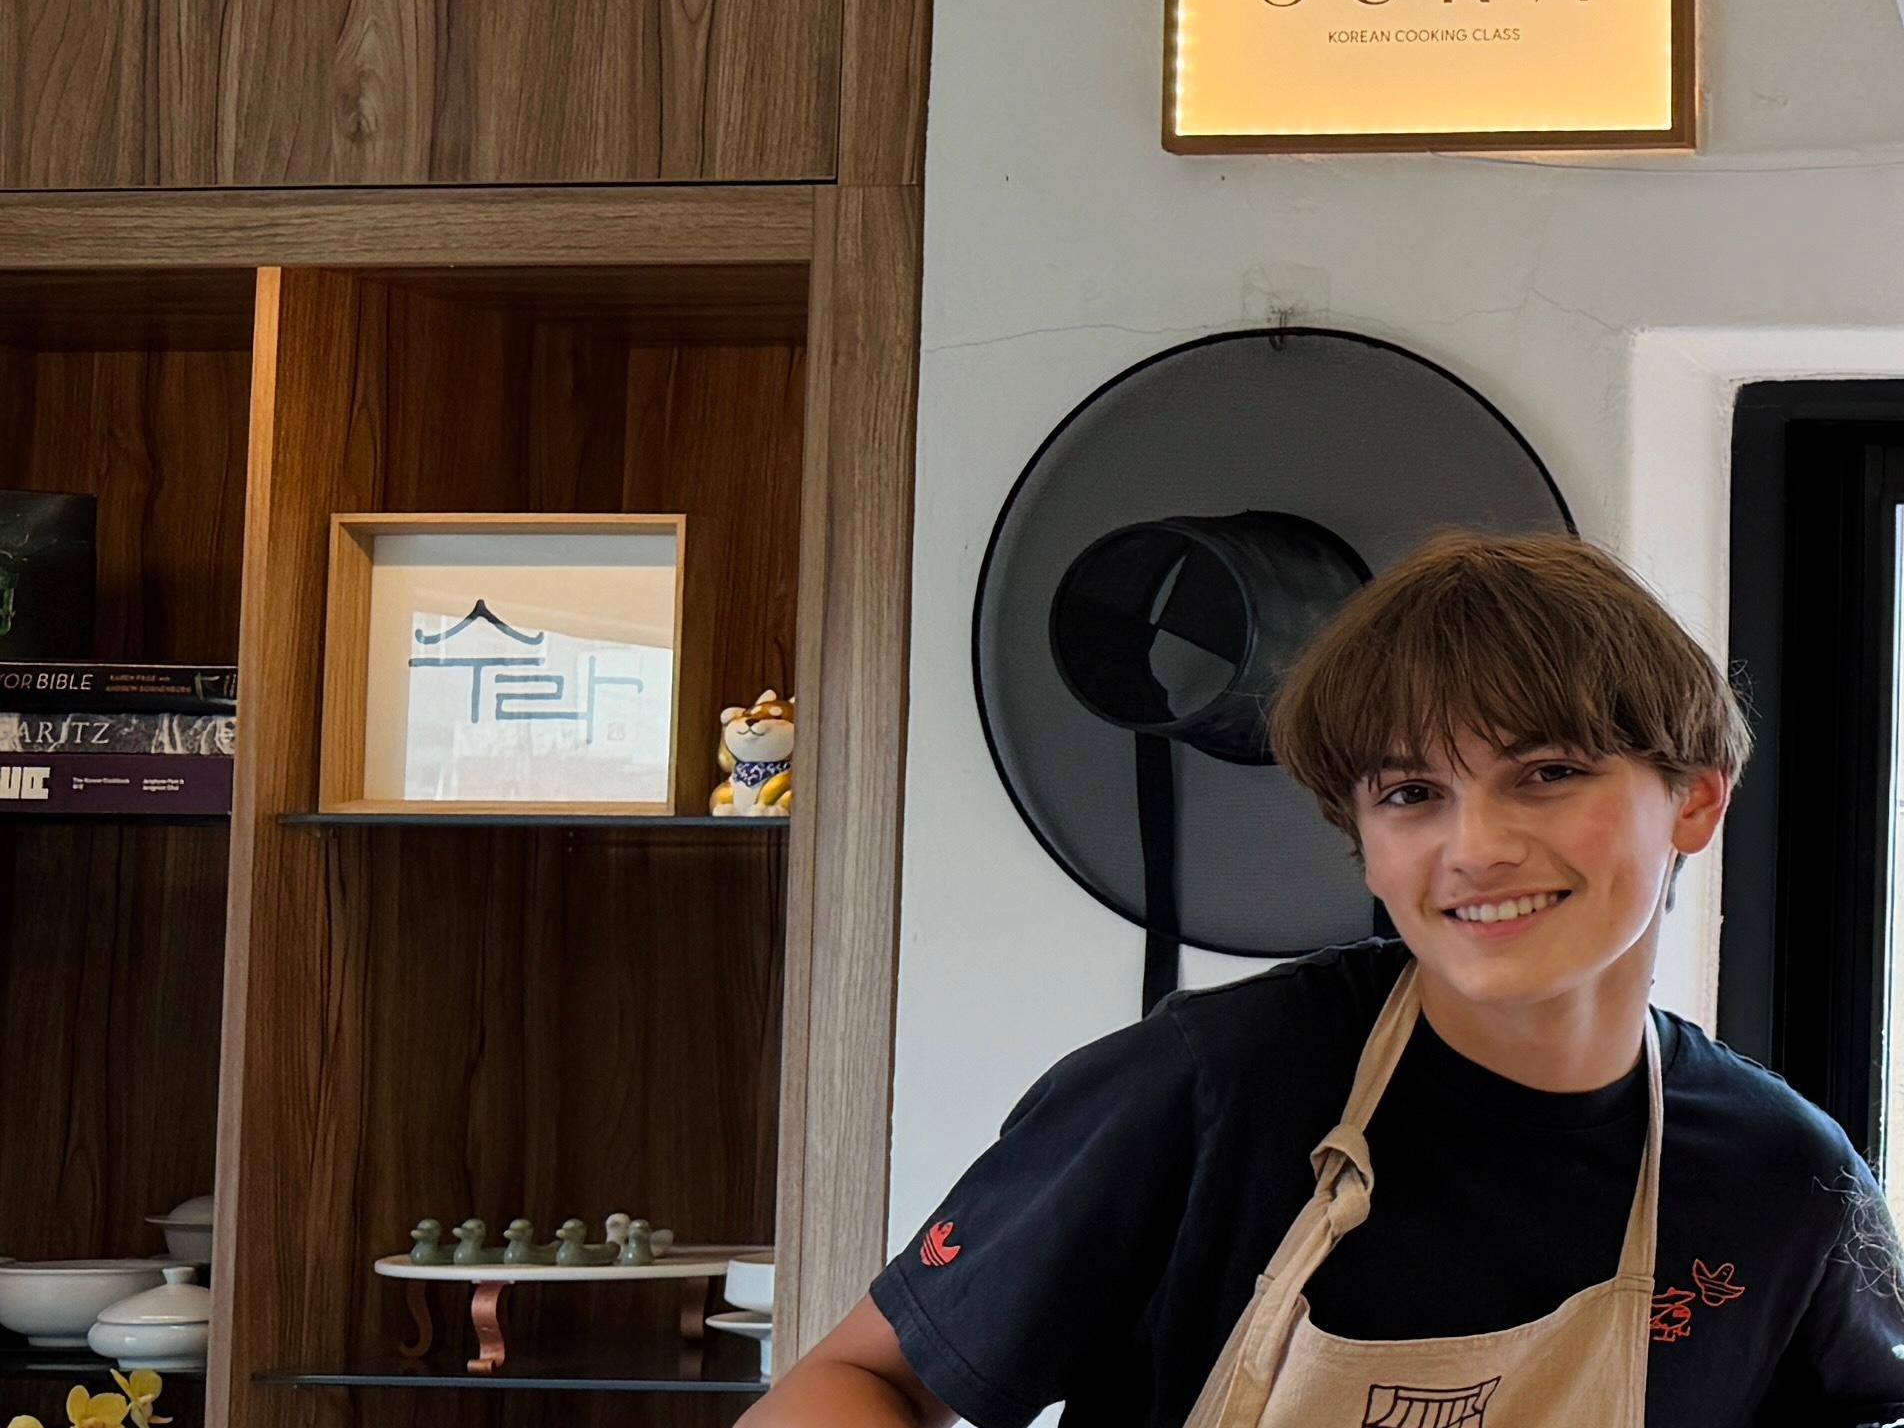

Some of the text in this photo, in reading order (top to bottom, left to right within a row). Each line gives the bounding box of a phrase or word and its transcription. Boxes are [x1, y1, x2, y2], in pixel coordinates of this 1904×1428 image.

[1328, 27, 1521, 44] KOREAN COOKING CLASS
[36, 672, 94, 691] BIBLE
